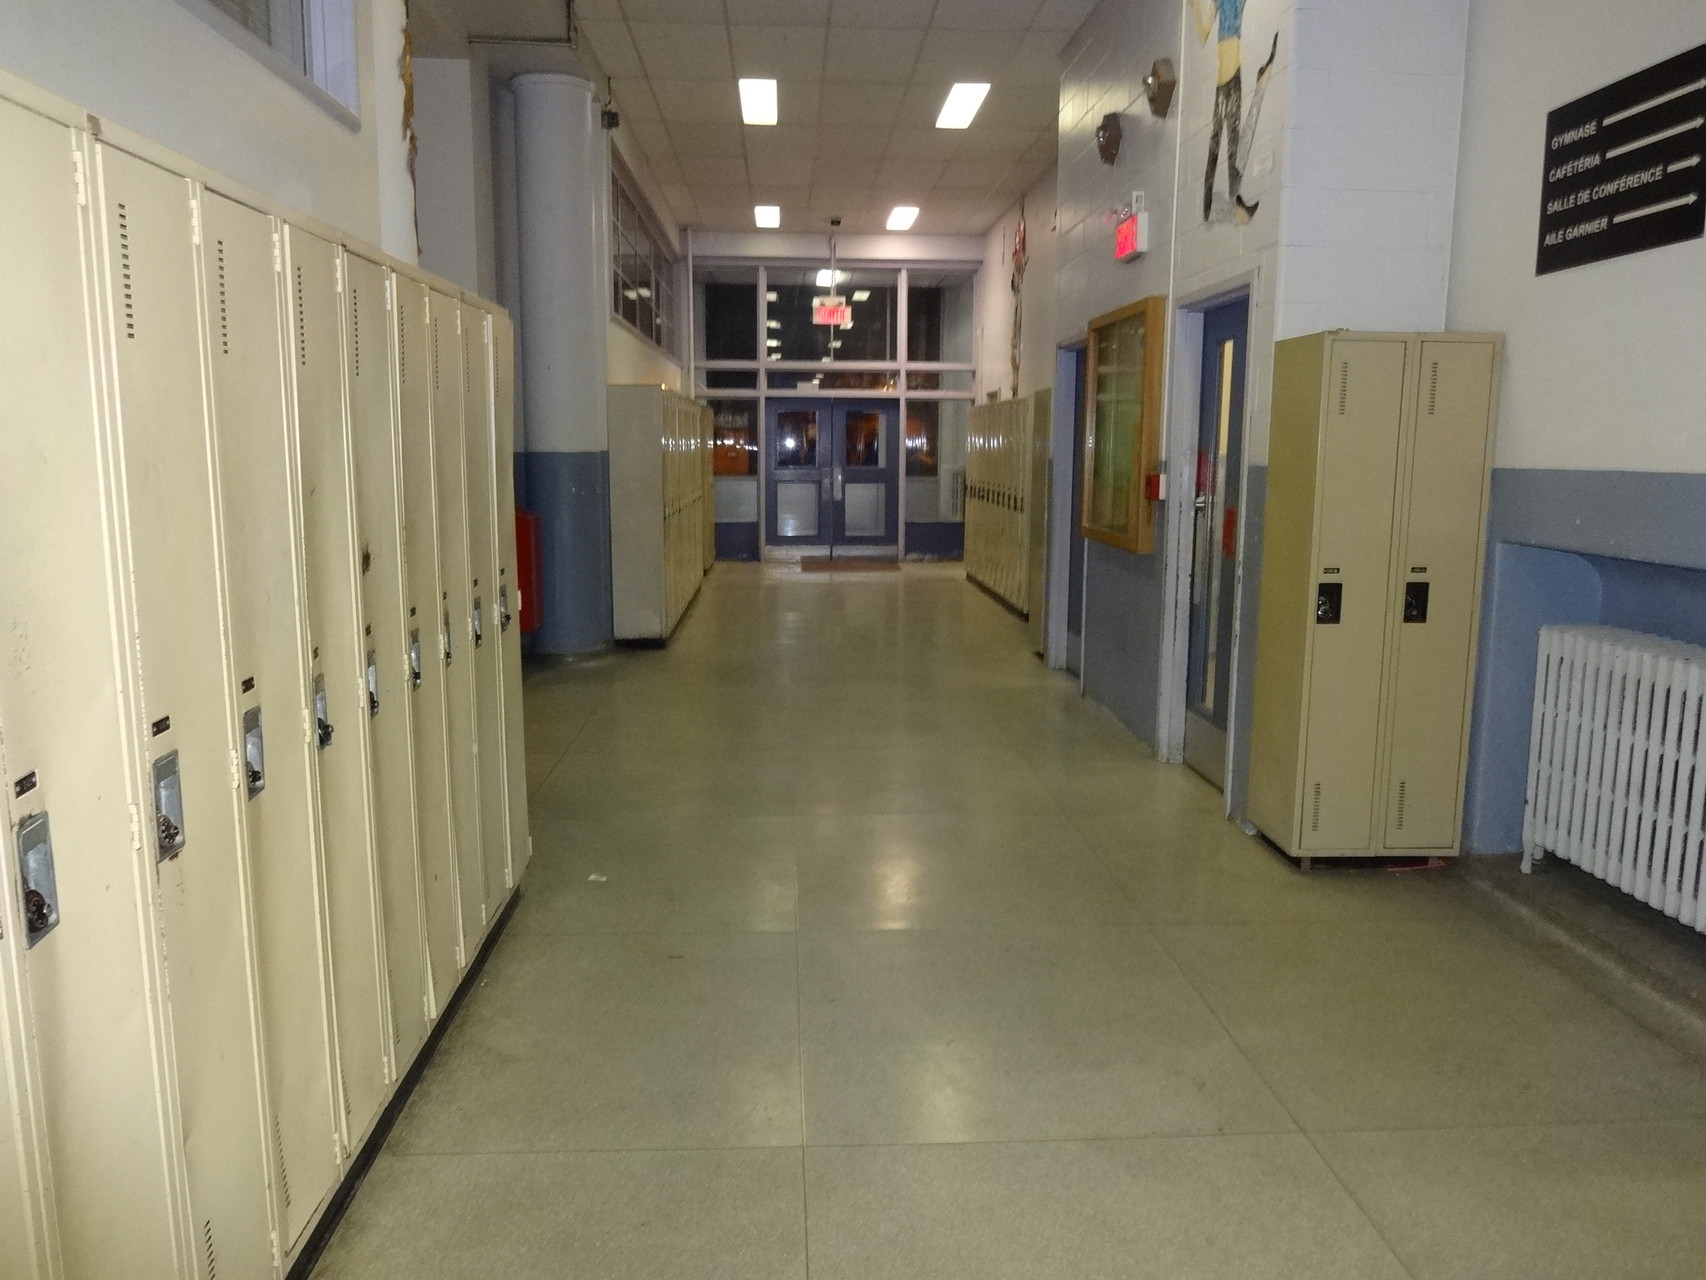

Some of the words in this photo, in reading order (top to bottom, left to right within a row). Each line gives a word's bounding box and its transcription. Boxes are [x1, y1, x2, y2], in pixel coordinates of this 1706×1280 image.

[1551, 120, 1598, 150] GYMNASE
[1548, 153, 1601, 183] CAFÉTÉRIA
[1546, 195, 1576, 215] SALLE
[1577, 189, 1591, 205] DE
[1592, 166, 1663, 200] CONFÉRENCE
[1543, 230, 1564, 247] AILE
[1565, 216, 1609, 241] GARNIER
